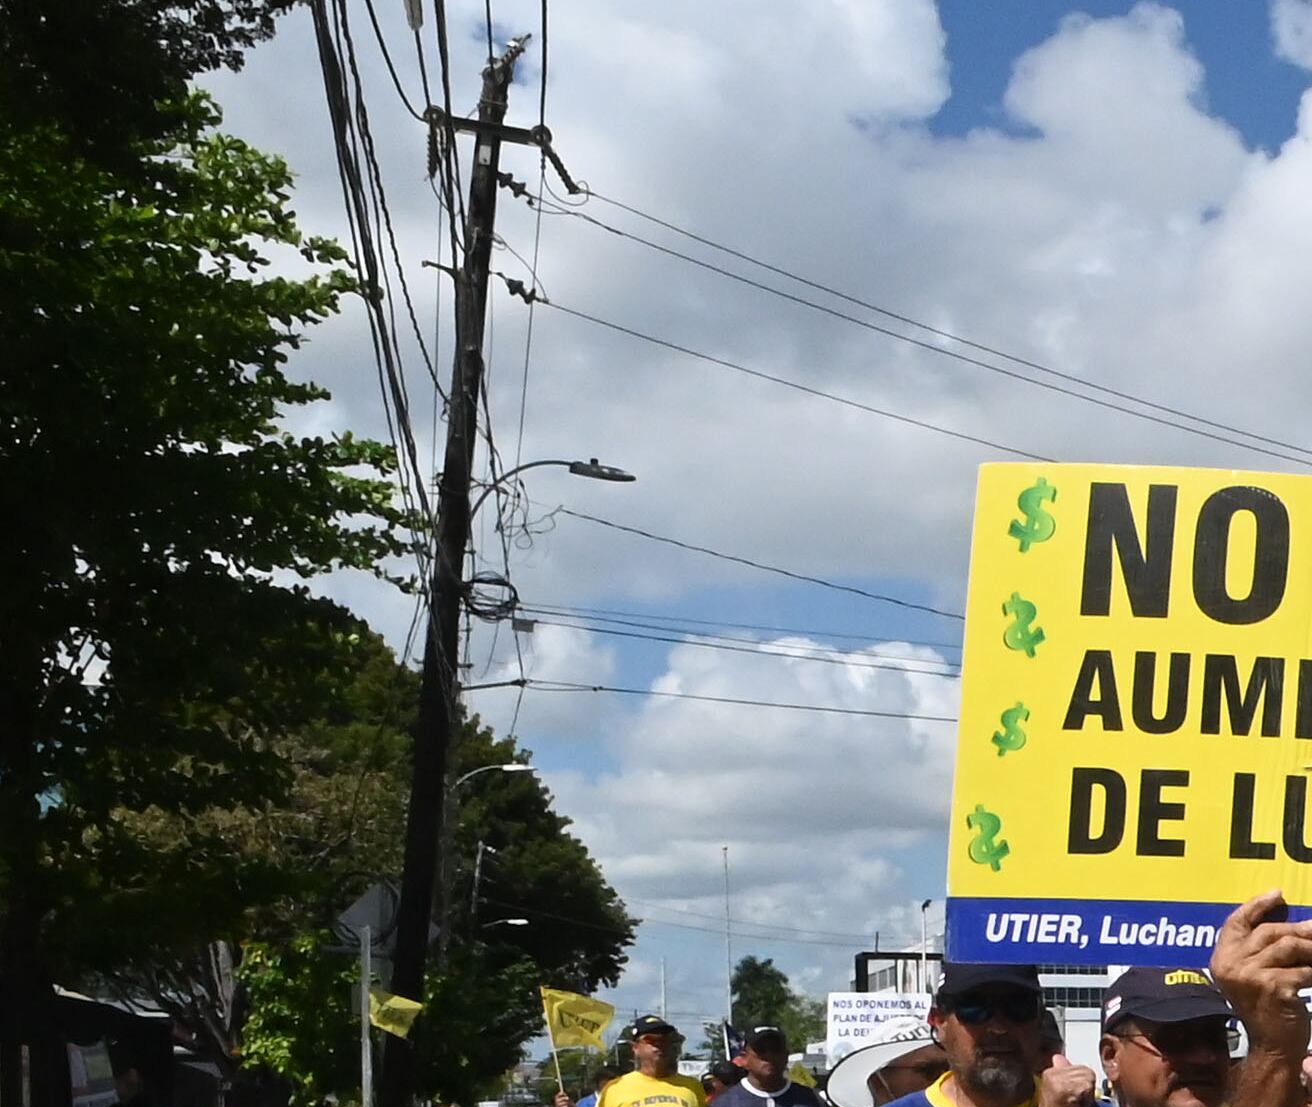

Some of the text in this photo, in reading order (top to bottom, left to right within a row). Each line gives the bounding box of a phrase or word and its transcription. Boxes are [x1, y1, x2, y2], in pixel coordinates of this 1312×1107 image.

[1081, 483, 1289, 624] NO
[1068, 768, 1189, 856] DE
[986, 913, 1089, 948] UTIER,
[1100, 917, 1222, 948] Luchan
[833, 1000, 853, 1009] NOS
[856, 1000, 912, 1009] OPONEMOS
